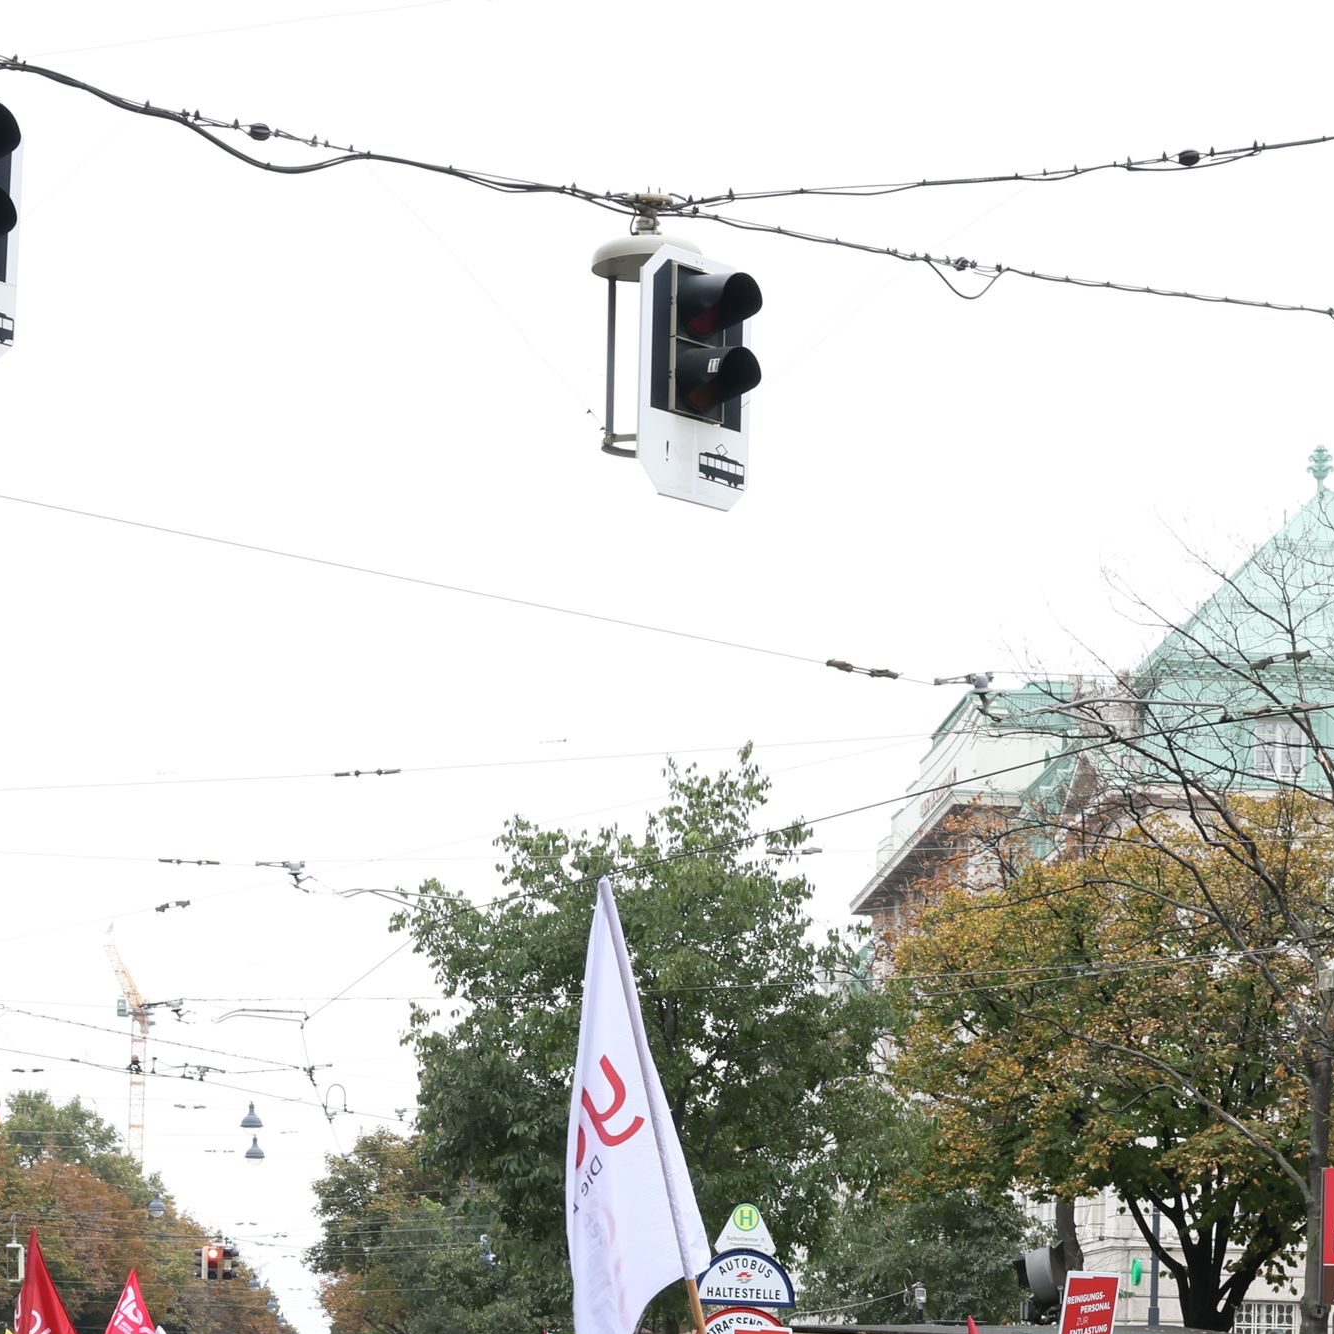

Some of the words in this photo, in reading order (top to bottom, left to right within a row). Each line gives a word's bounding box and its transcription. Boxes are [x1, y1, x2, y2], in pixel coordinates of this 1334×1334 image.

[740, 1209, 753, 1227] H
[718, 1258, 773, 1279] AUTOBUS
[707, 1287, 782, 1301] HALTESTELLE
[1067, 1291, 1105, 1305] REINIGUNGS-
[1080, 1302, 1111, 1314] PERSONAL
[1076, 1316, 1089, 1326] ZUR
